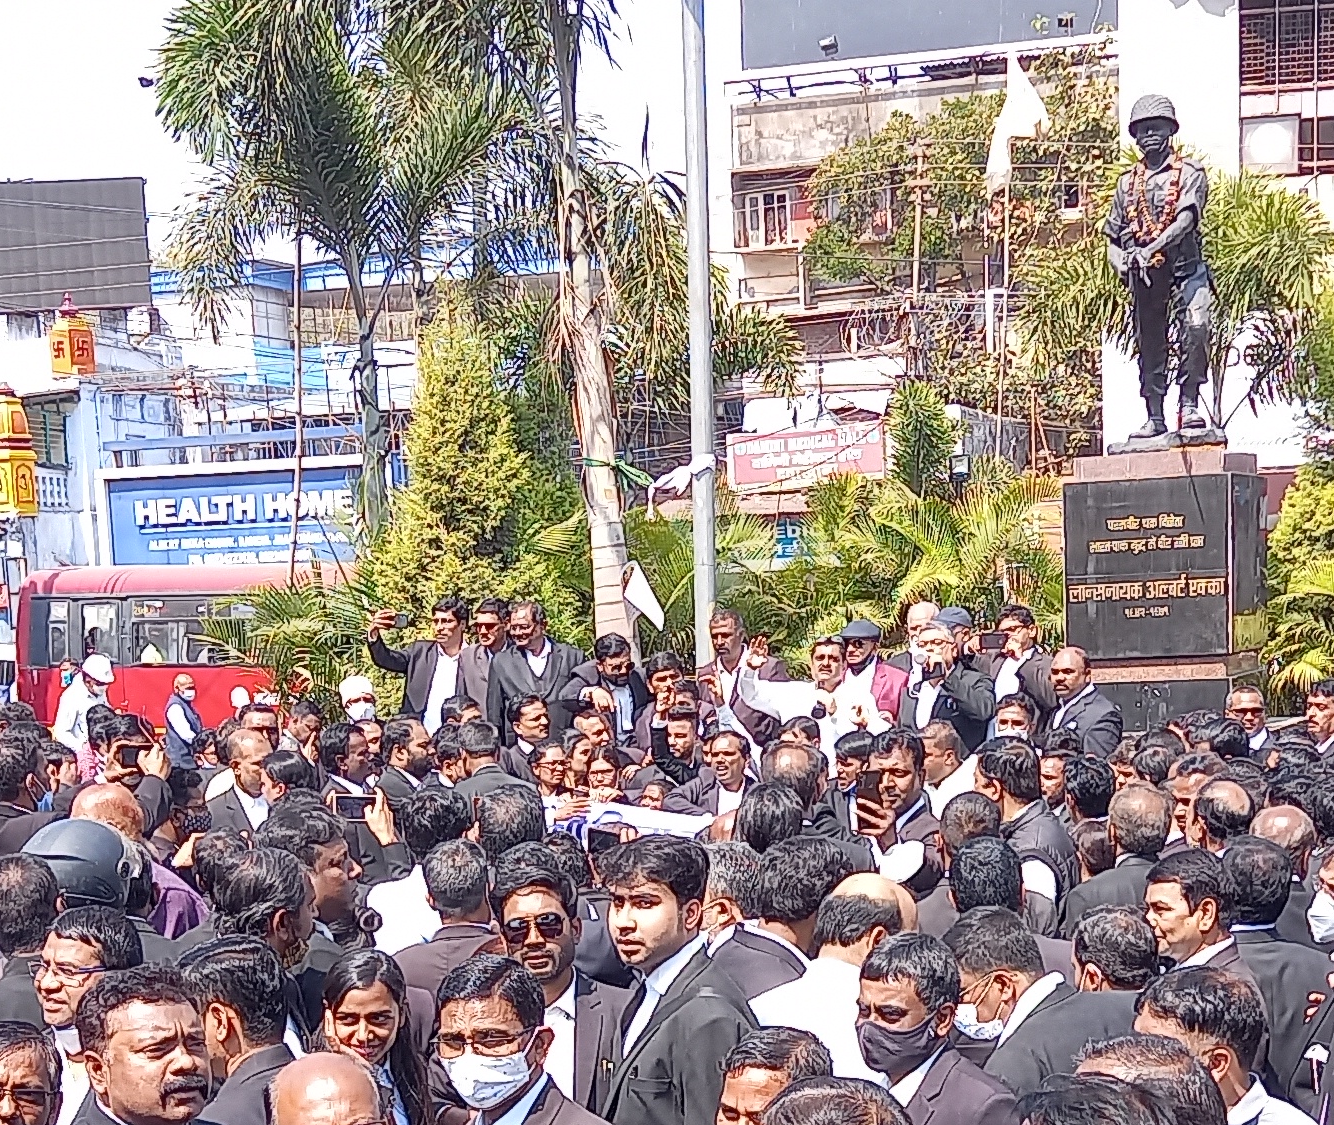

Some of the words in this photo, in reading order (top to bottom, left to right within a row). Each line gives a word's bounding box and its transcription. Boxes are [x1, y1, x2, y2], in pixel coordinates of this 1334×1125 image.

[134, 493, 256, 526] HEALTH
[263, 489, 354, 520] HOME
[1068, 581, 1144, 603] लान्सनायक
[1146, 572, 1186, 600] अल्बर्ट
[1188, 577, 1226, 597] एक्का
